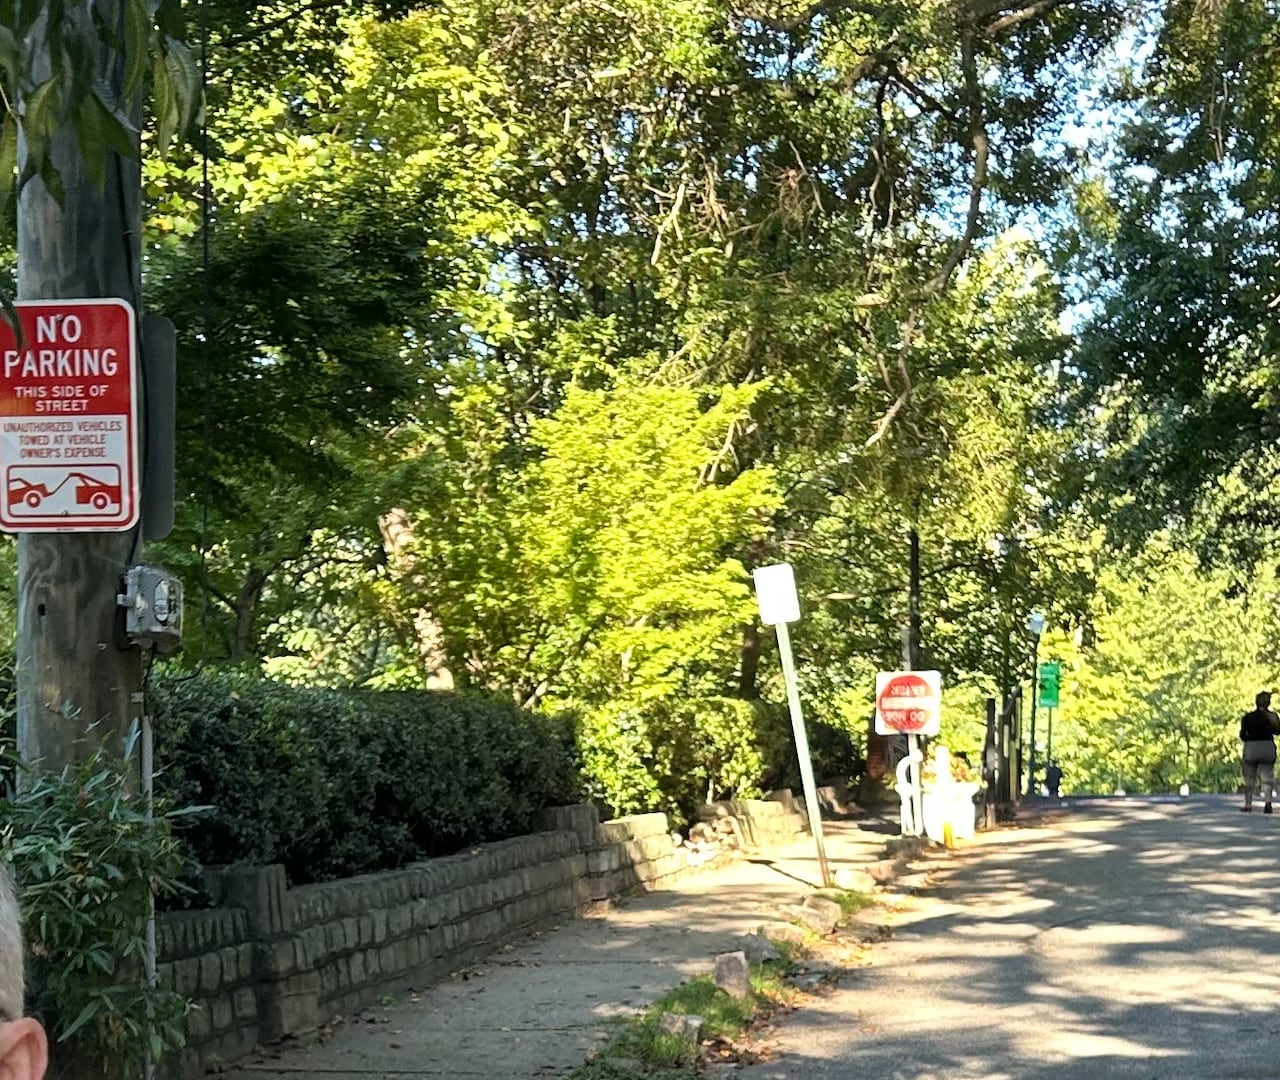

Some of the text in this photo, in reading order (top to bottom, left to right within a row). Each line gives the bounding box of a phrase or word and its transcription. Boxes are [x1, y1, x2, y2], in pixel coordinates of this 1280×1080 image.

[36, 314, 82, 344] NO
[4, 348, 118, 378] PARKING
[14, 384, 109, 398] THIS SIDE OF
[35, 399, 89, 412] STREET
[3, 421, 122, 433] UNAUTHORIZED VEHICLES
[19, 434, 106, 445] TOWED AT VEHICLE
[20, 447, 106, 459] OWNER'S EXPENSE
